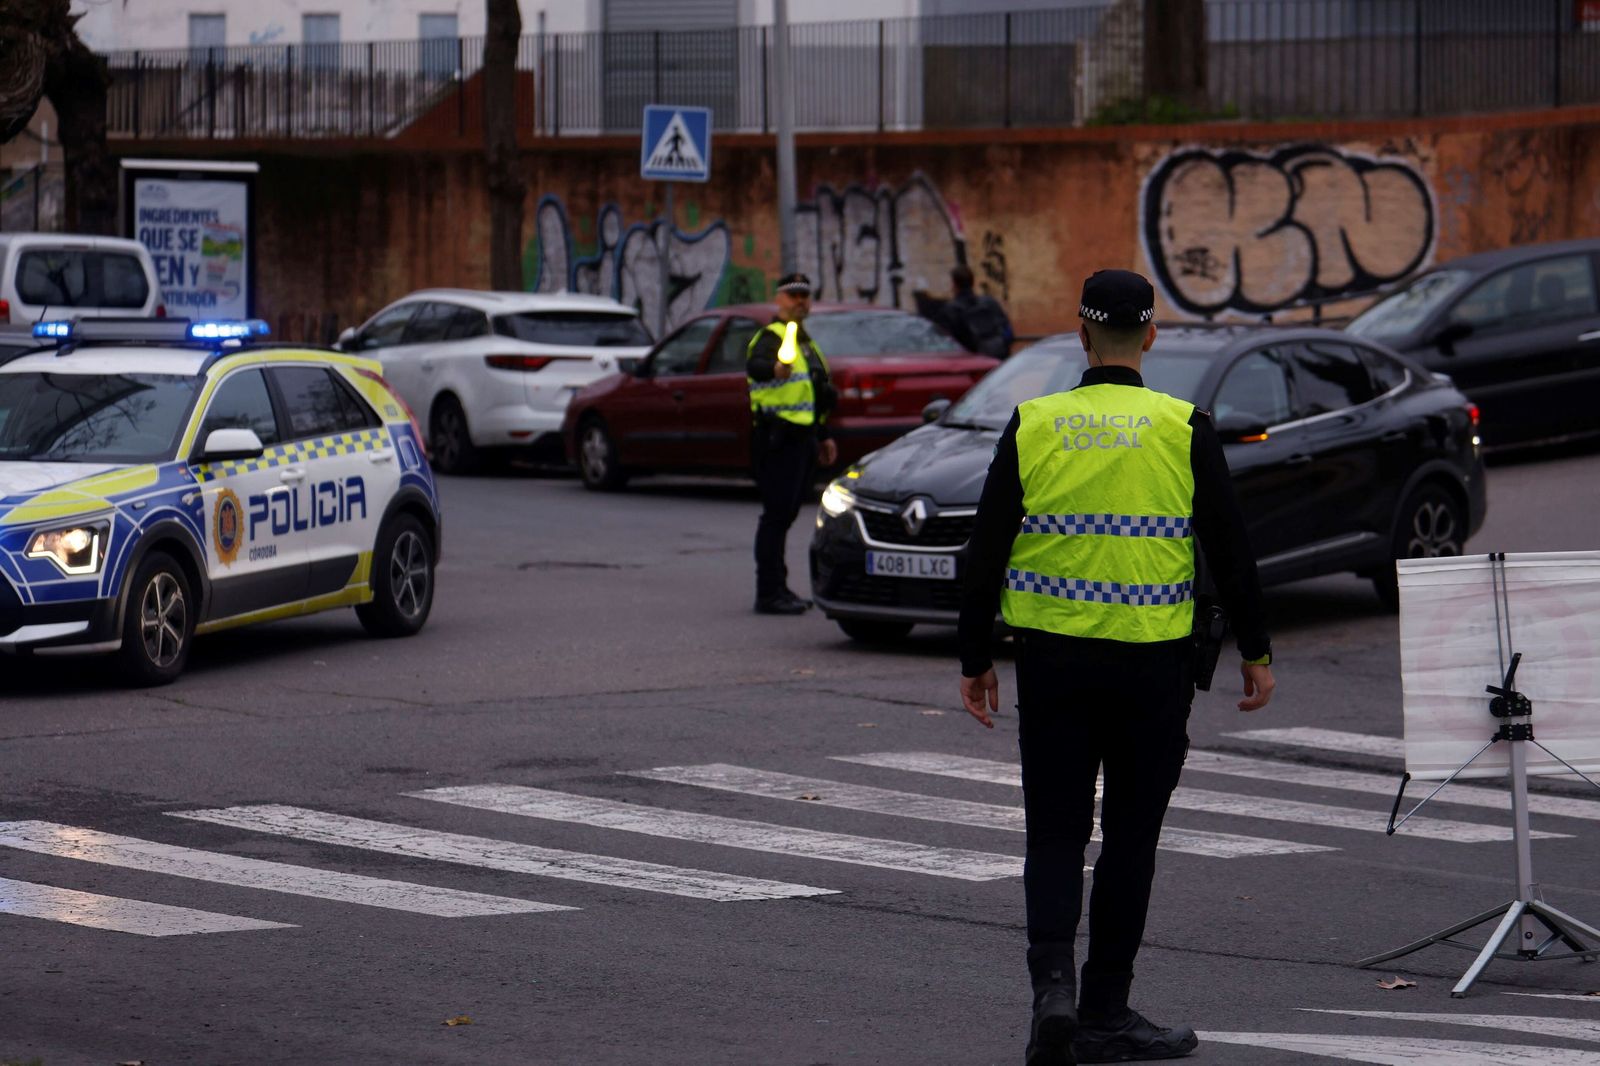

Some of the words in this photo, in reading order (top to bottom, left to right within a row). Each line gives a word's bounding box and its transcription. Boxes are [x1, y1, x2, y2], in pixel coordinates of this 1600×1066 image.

[139, 226, 174, 251] QUE
[178, 227, 198, 252] SE
[1054, 414, 1153, 433] POLICIA
[1063, 432, 1143, 451] LOCAL
[876, 555, 914, 574] 4081
[918, 557, 950, 576] LXC
